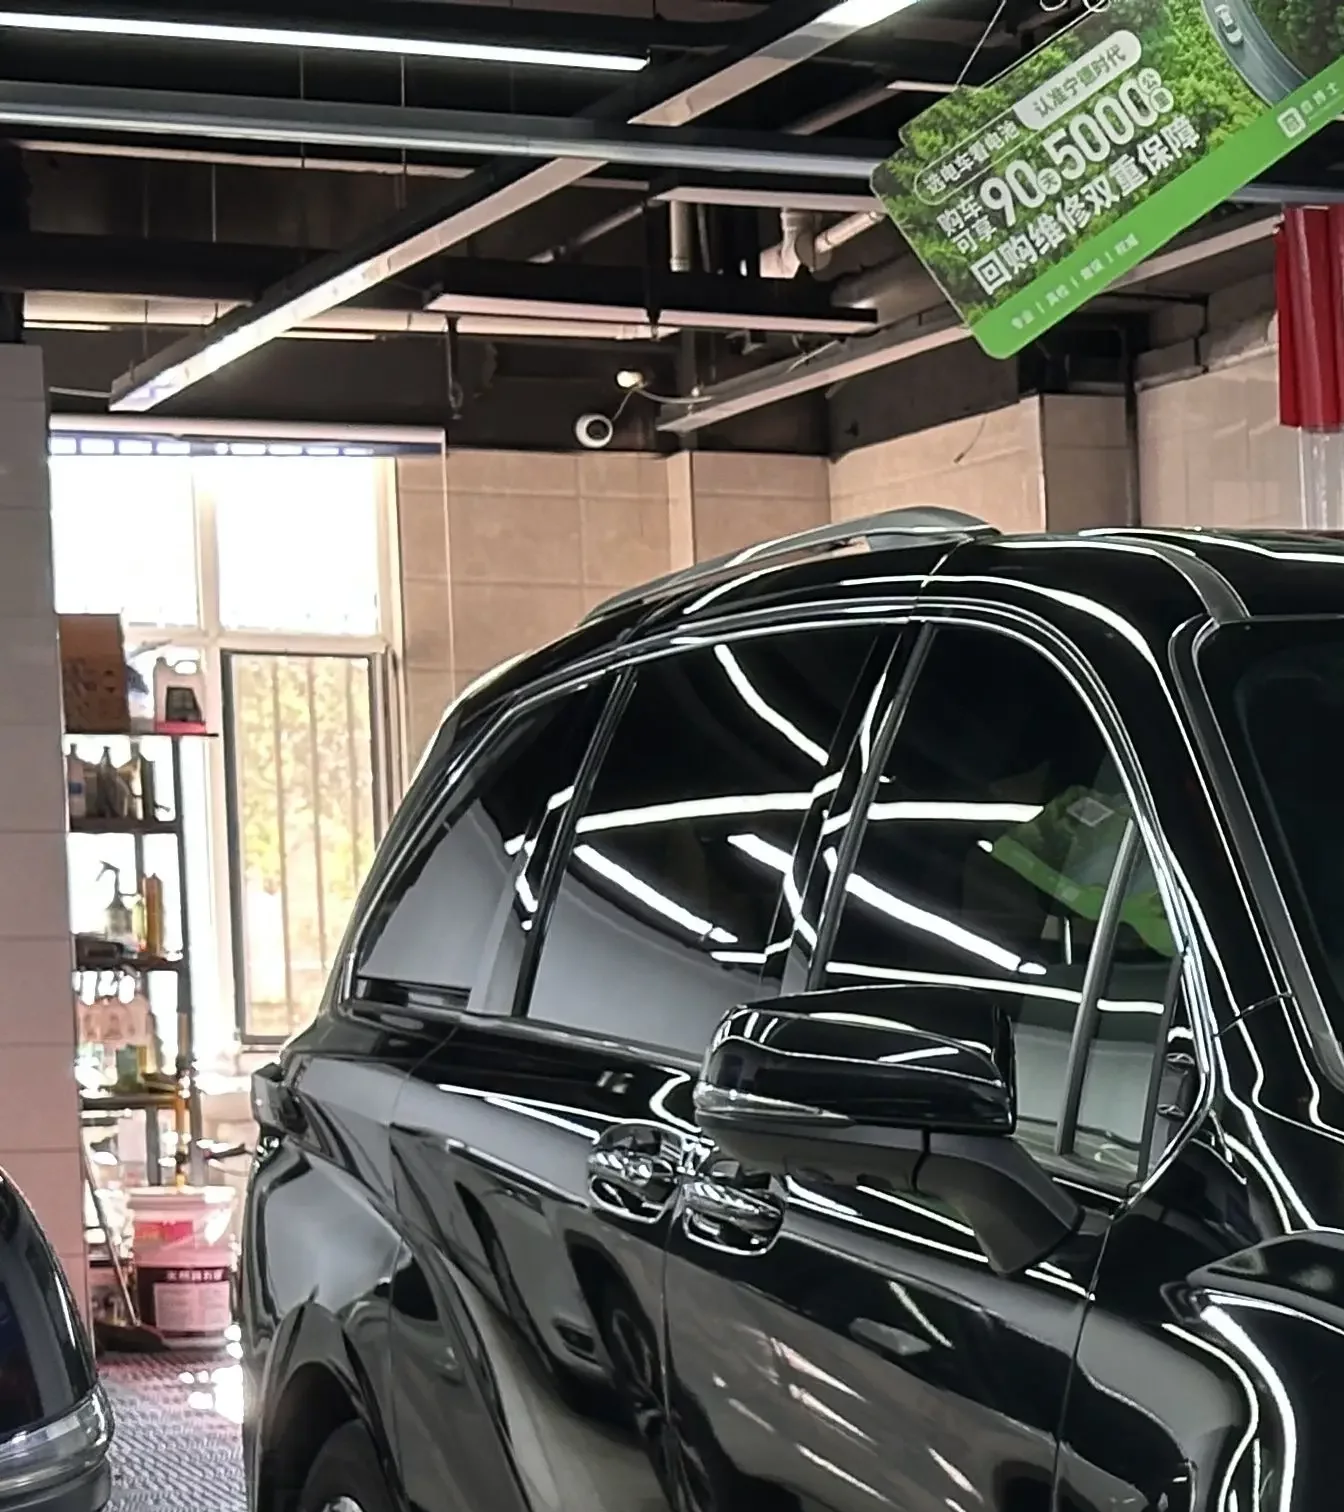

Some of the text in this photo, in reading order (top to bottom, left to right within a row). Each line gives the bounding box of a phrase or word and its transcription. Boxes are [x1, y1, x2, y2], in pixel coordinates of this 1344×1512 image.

[1032, 44, 1126, 118] 认准宁时代
[936, 193, 983, 237] 购车
[952, 214, 997, 254] 可享
[969, 115, 1201, 296] 回购维修双重保障
